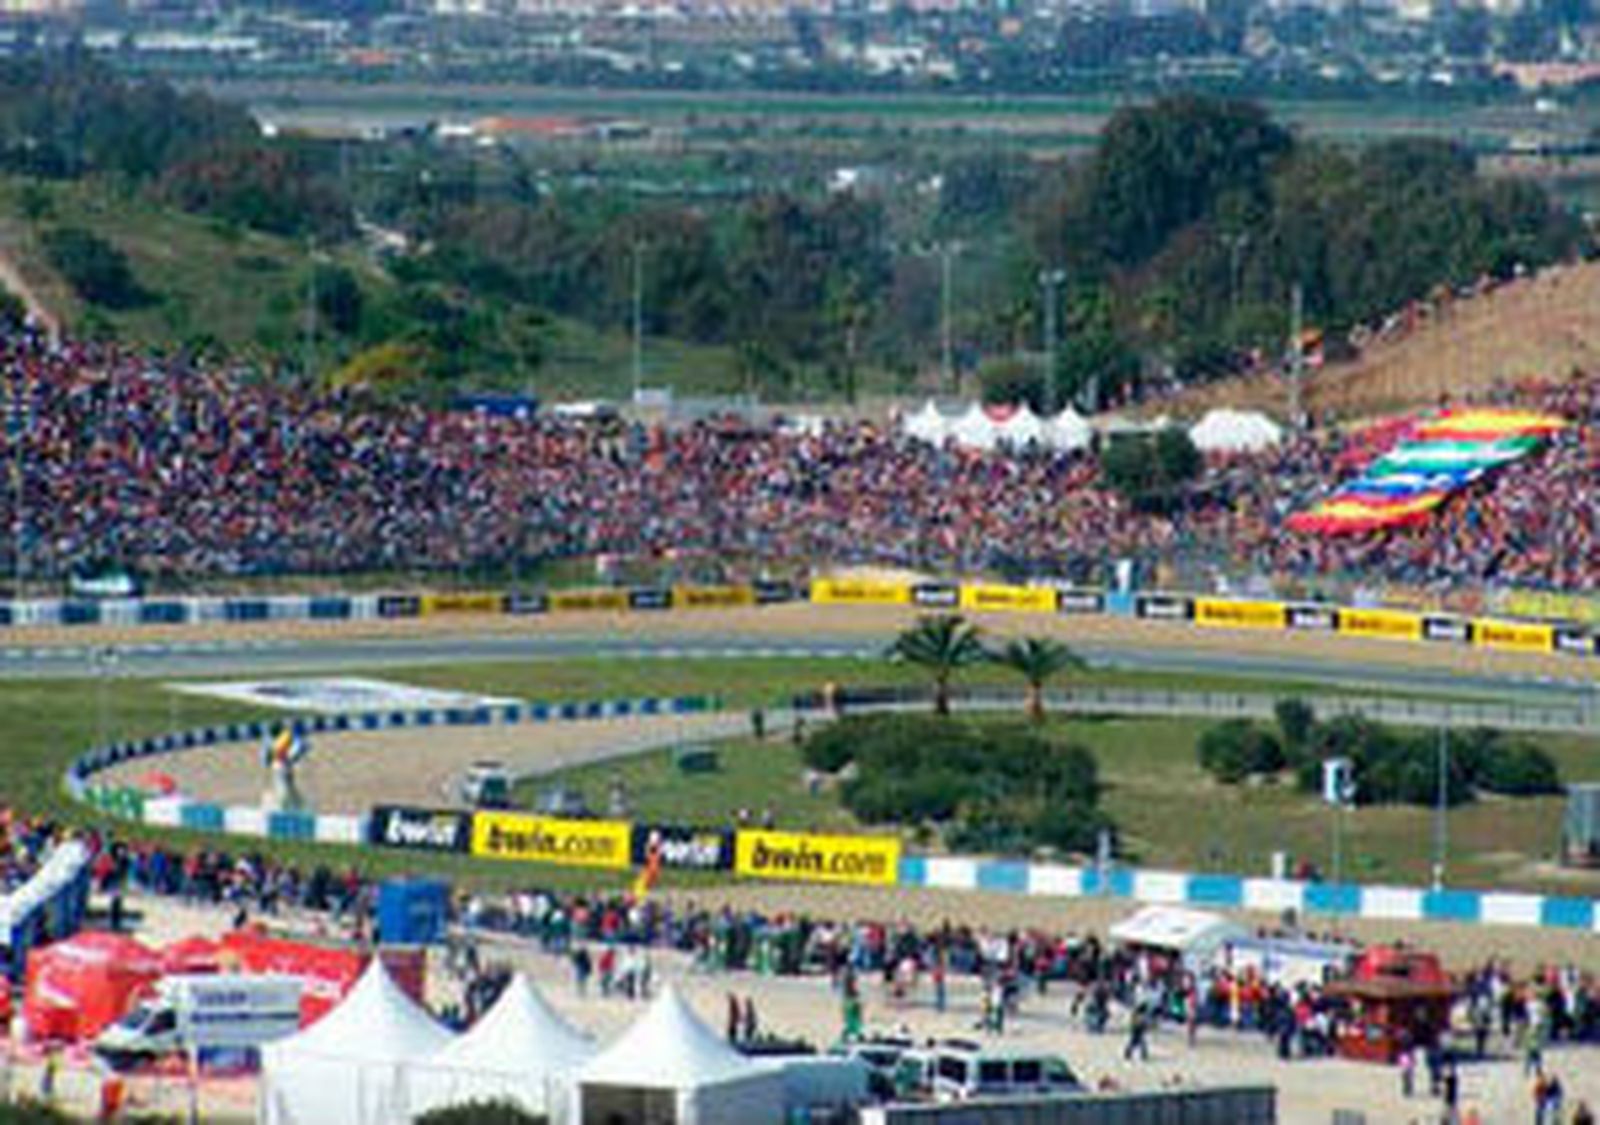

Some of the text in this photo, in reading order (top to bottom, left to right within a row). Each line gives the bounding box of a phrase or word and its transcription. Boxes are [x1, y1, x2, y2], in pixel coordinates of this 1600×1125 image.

[386, 810, 458, 848] bwin
[486, 823, 617, 857] bwin.com
[751, 837, 887, 877] bwin.com
